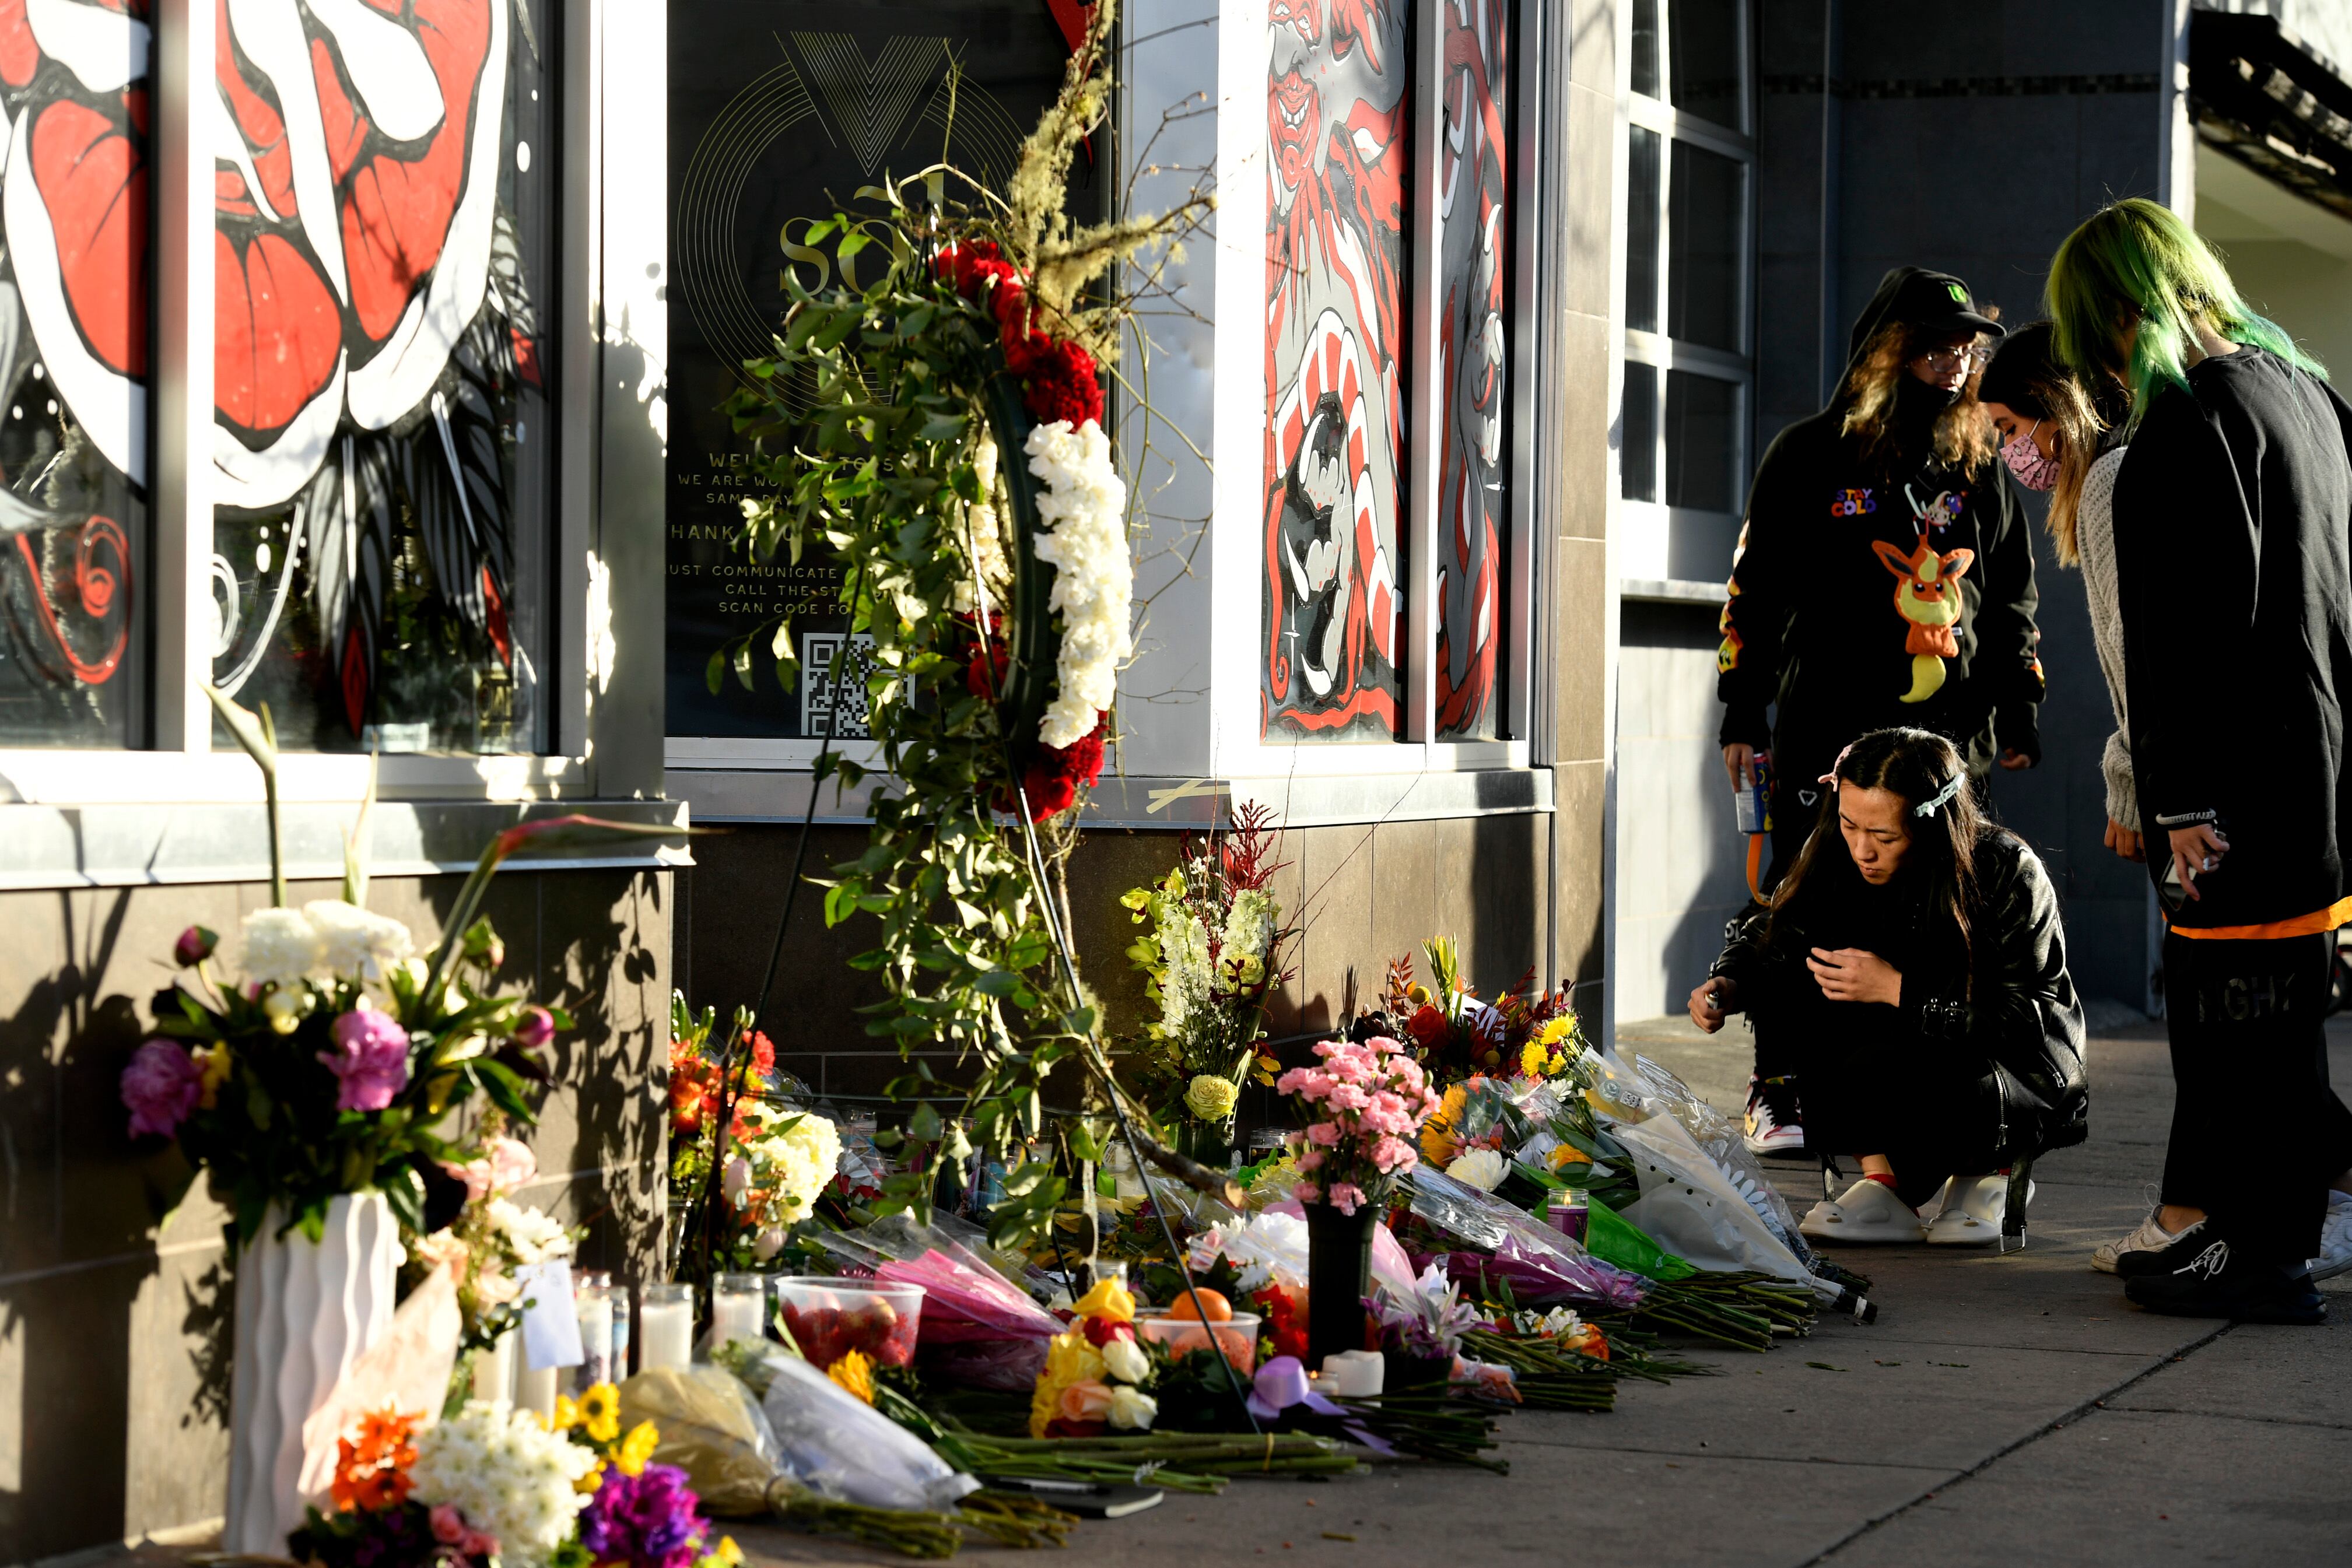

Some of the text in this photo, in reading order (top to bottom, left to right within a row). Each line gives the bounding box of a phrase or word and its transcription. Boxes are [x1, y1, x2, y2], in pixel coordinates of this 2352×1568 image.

[709, 453, 821, 470] WELME
[839, 457, 867, 471] TO
[678, 474, 701, 486] WE
[711, 475, 743, 486] ARE
[1836, 487, 1873, 501] STAY
[1831, 499, 1877, 518] COLD
[671, 524, 734, 540] HANK
[670, 564, 837, 578] UST COMMUNICATE
[725, 584, 767, 595] CALL
[777, 585, 809, 596] THE
[718, 602, 849, 615] SCAN CODE FO
